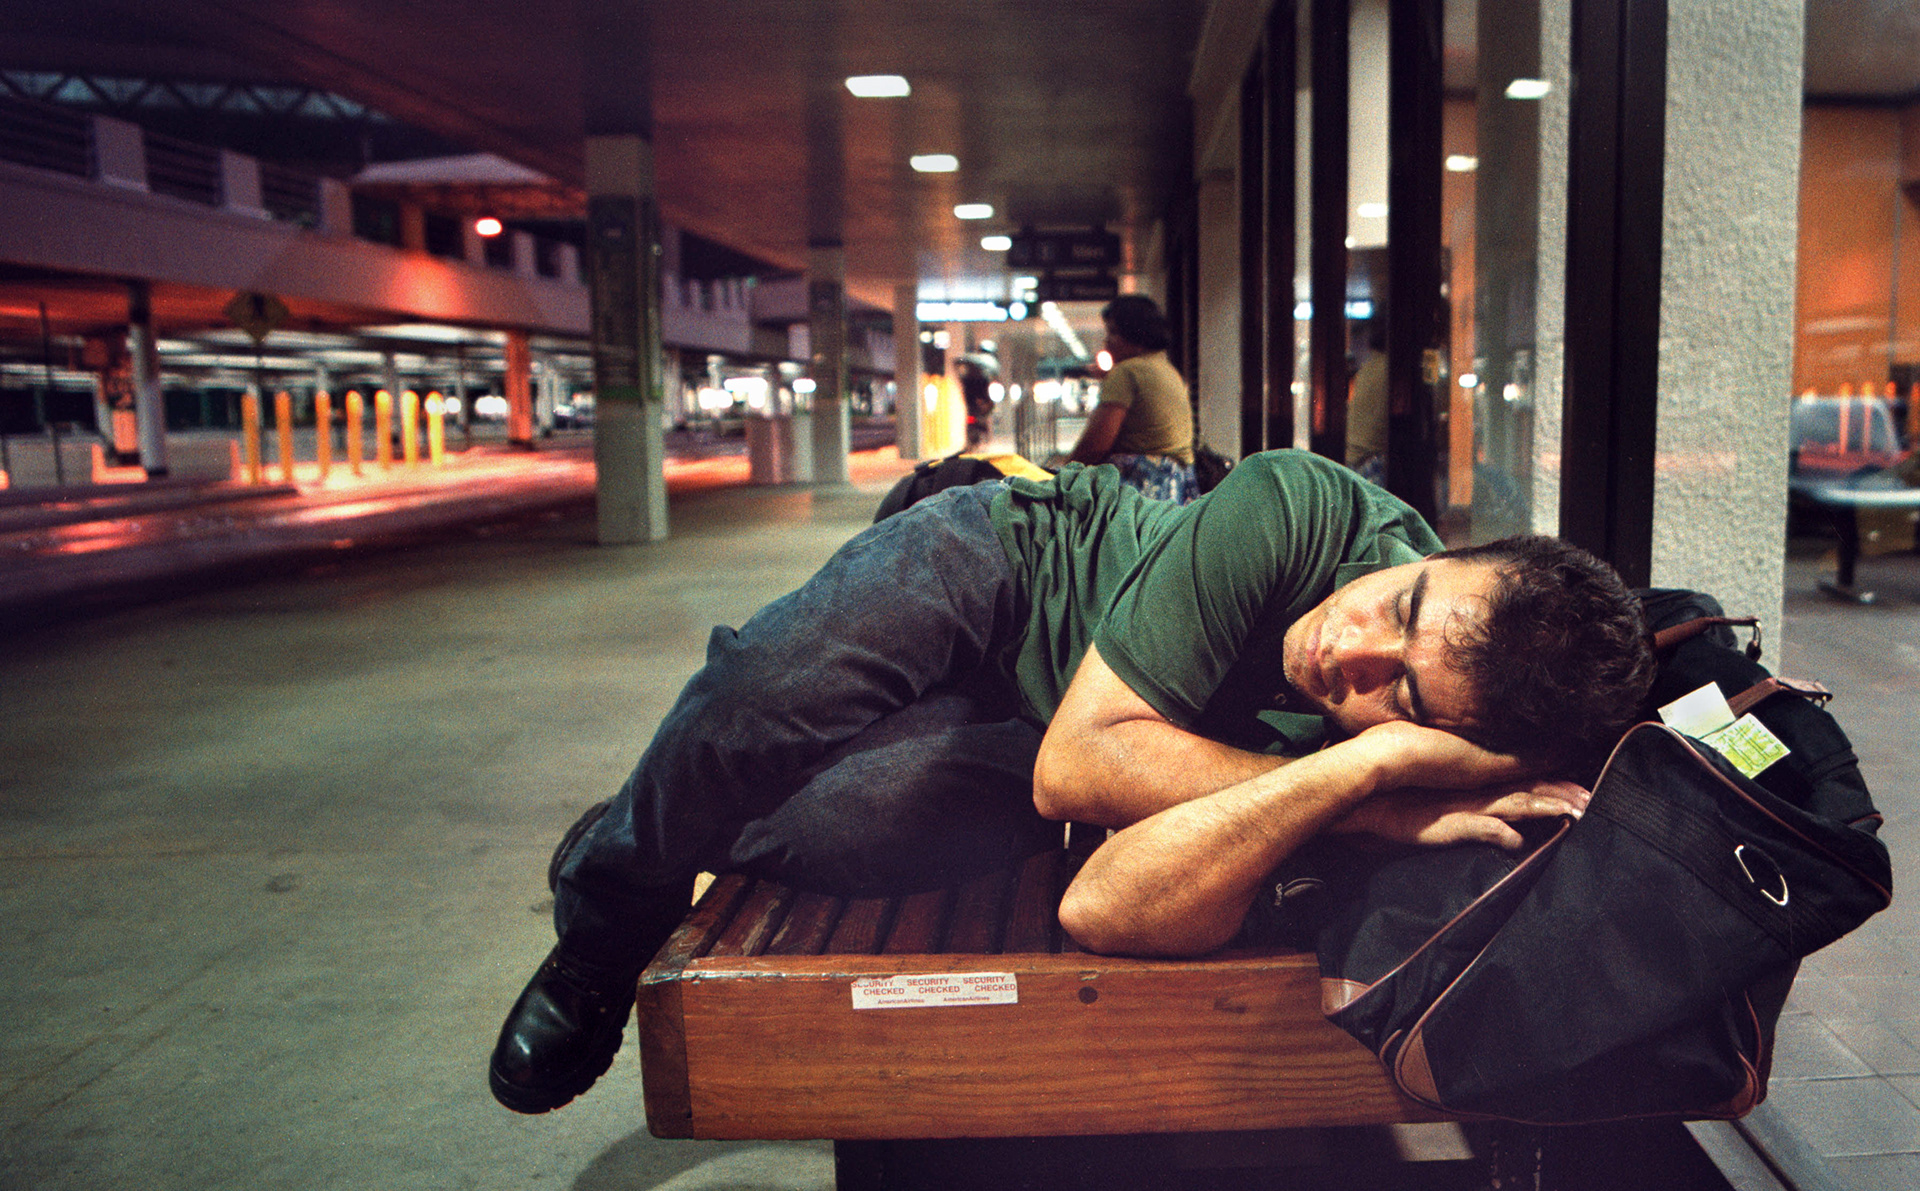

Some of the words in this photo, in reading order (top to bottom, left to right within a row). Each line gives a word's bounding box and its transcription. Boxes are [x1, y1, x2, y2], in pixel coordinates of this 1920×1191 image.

[907, 977, 949, 987] SECURITY
[963, 976, 1005, 985] SECURITY
[863, 987, 905, 996] CHECKED
[918, 985, 960, 994] CHECKED
[974, 983, 1016, 992] CHECKED
